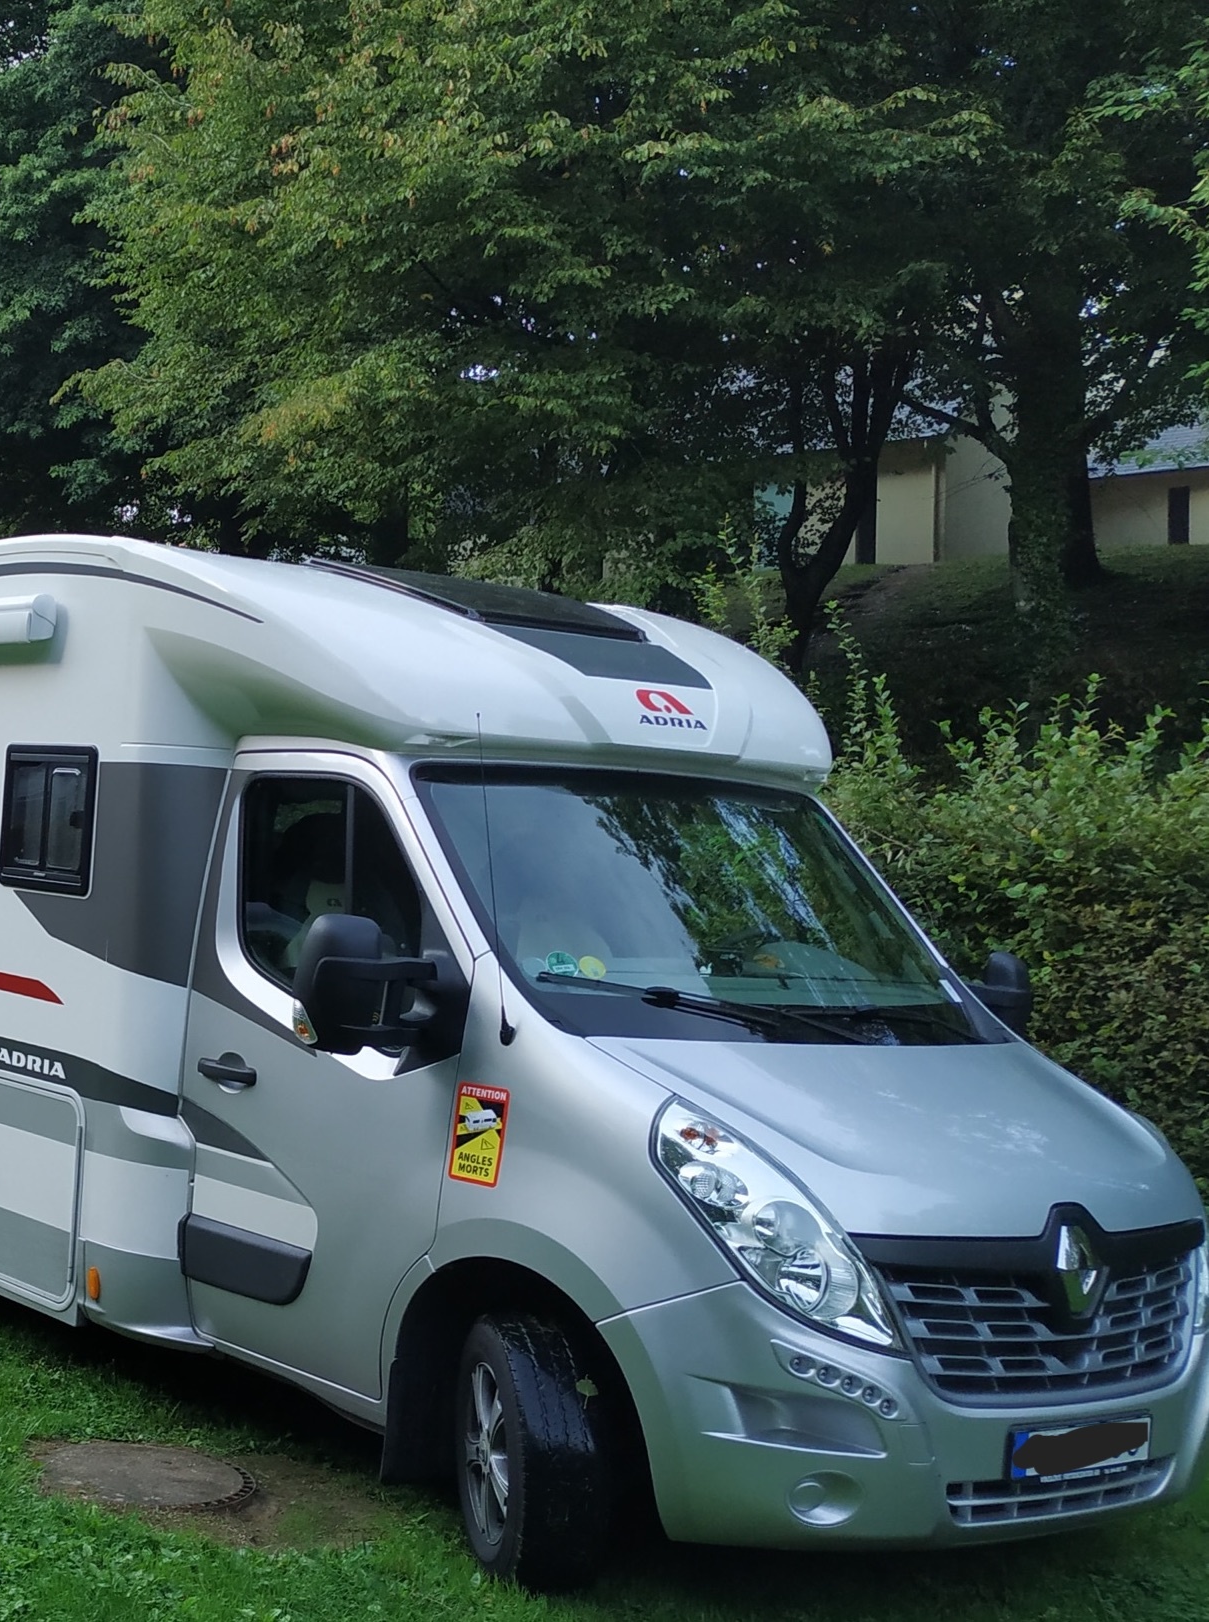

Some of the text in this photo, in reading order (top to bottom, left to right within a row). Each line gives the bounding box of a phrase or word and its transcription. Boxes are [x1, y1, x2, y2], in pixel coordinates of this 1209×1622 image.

[639, 714, 708, 731] ADRIA
[461, 1085, 507, 1101] ATTENTION
[458, 1151, 493, 1167] ANGLES
[458, 1162, 490, 1177] MORTS
